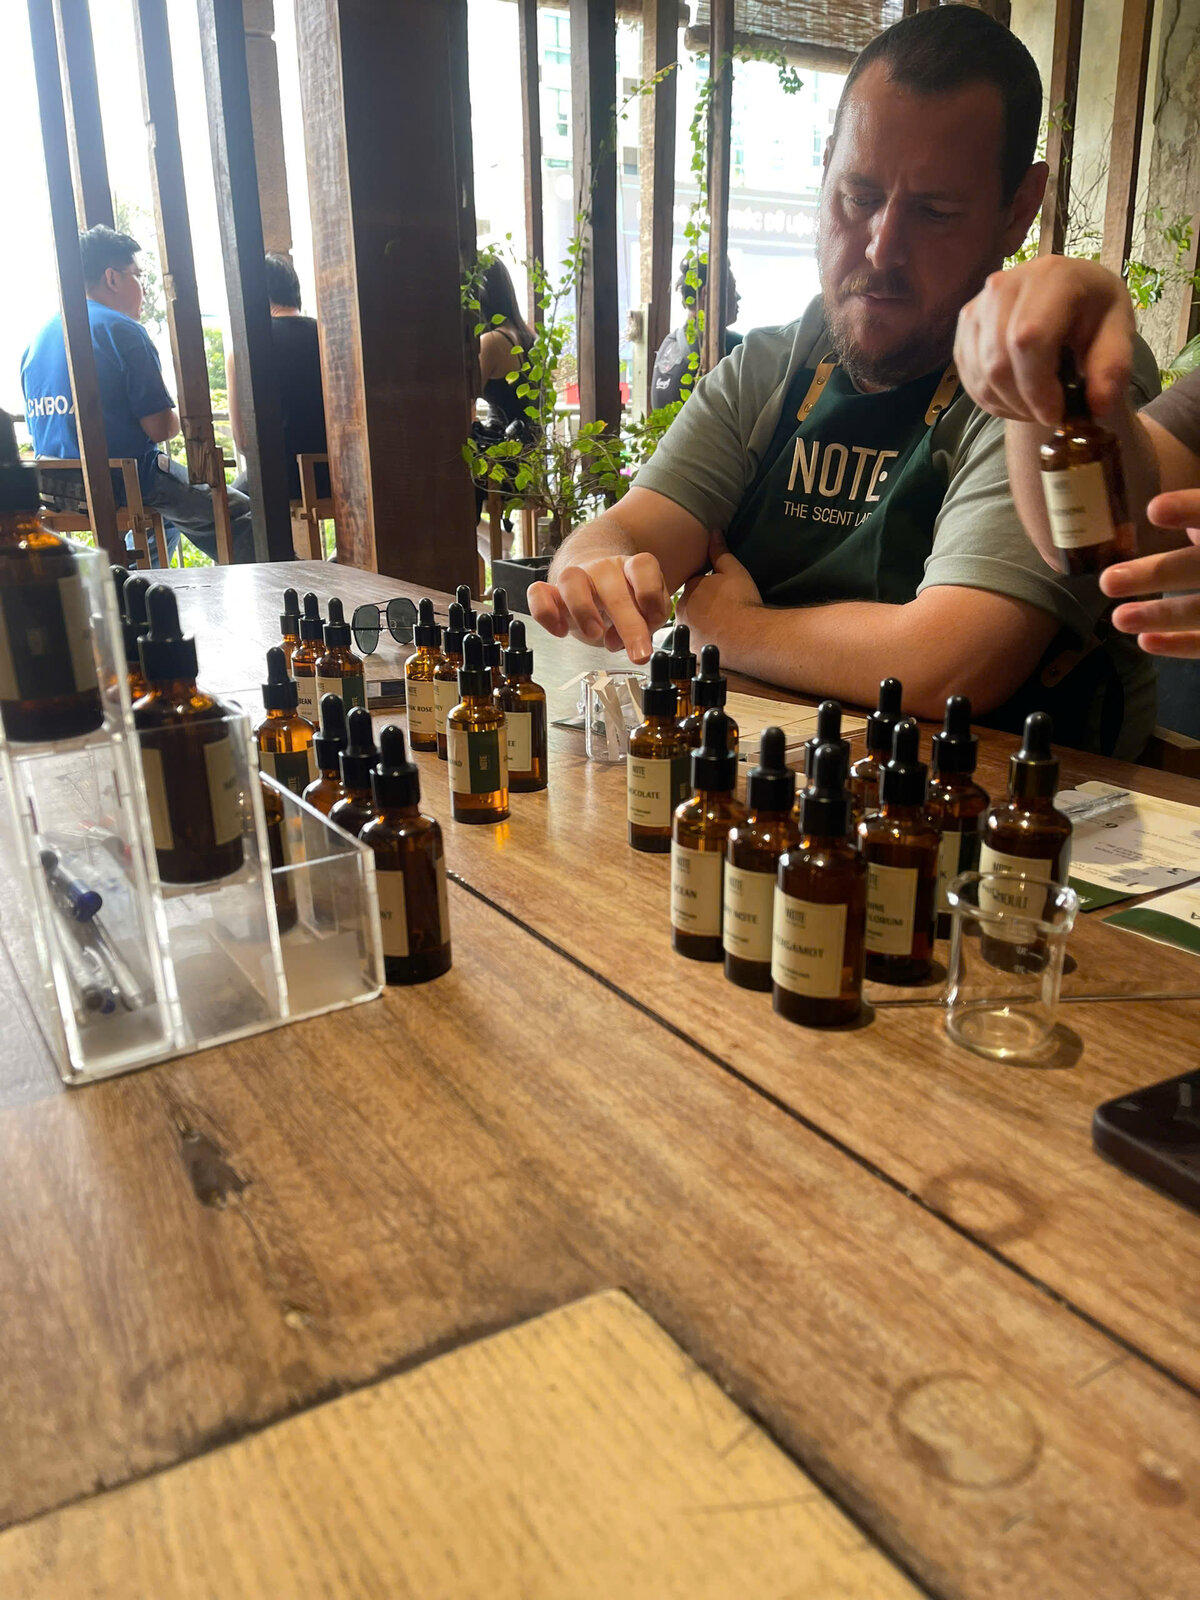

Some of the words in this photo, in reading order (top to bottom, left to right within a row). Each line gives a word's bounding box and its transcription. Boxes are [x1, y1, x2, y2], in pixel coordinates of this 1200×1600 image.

[787, 436, 899, 501] NOTE
[784, 500, 809, 519] THE
[812, 506, 854, 526] SCENT
